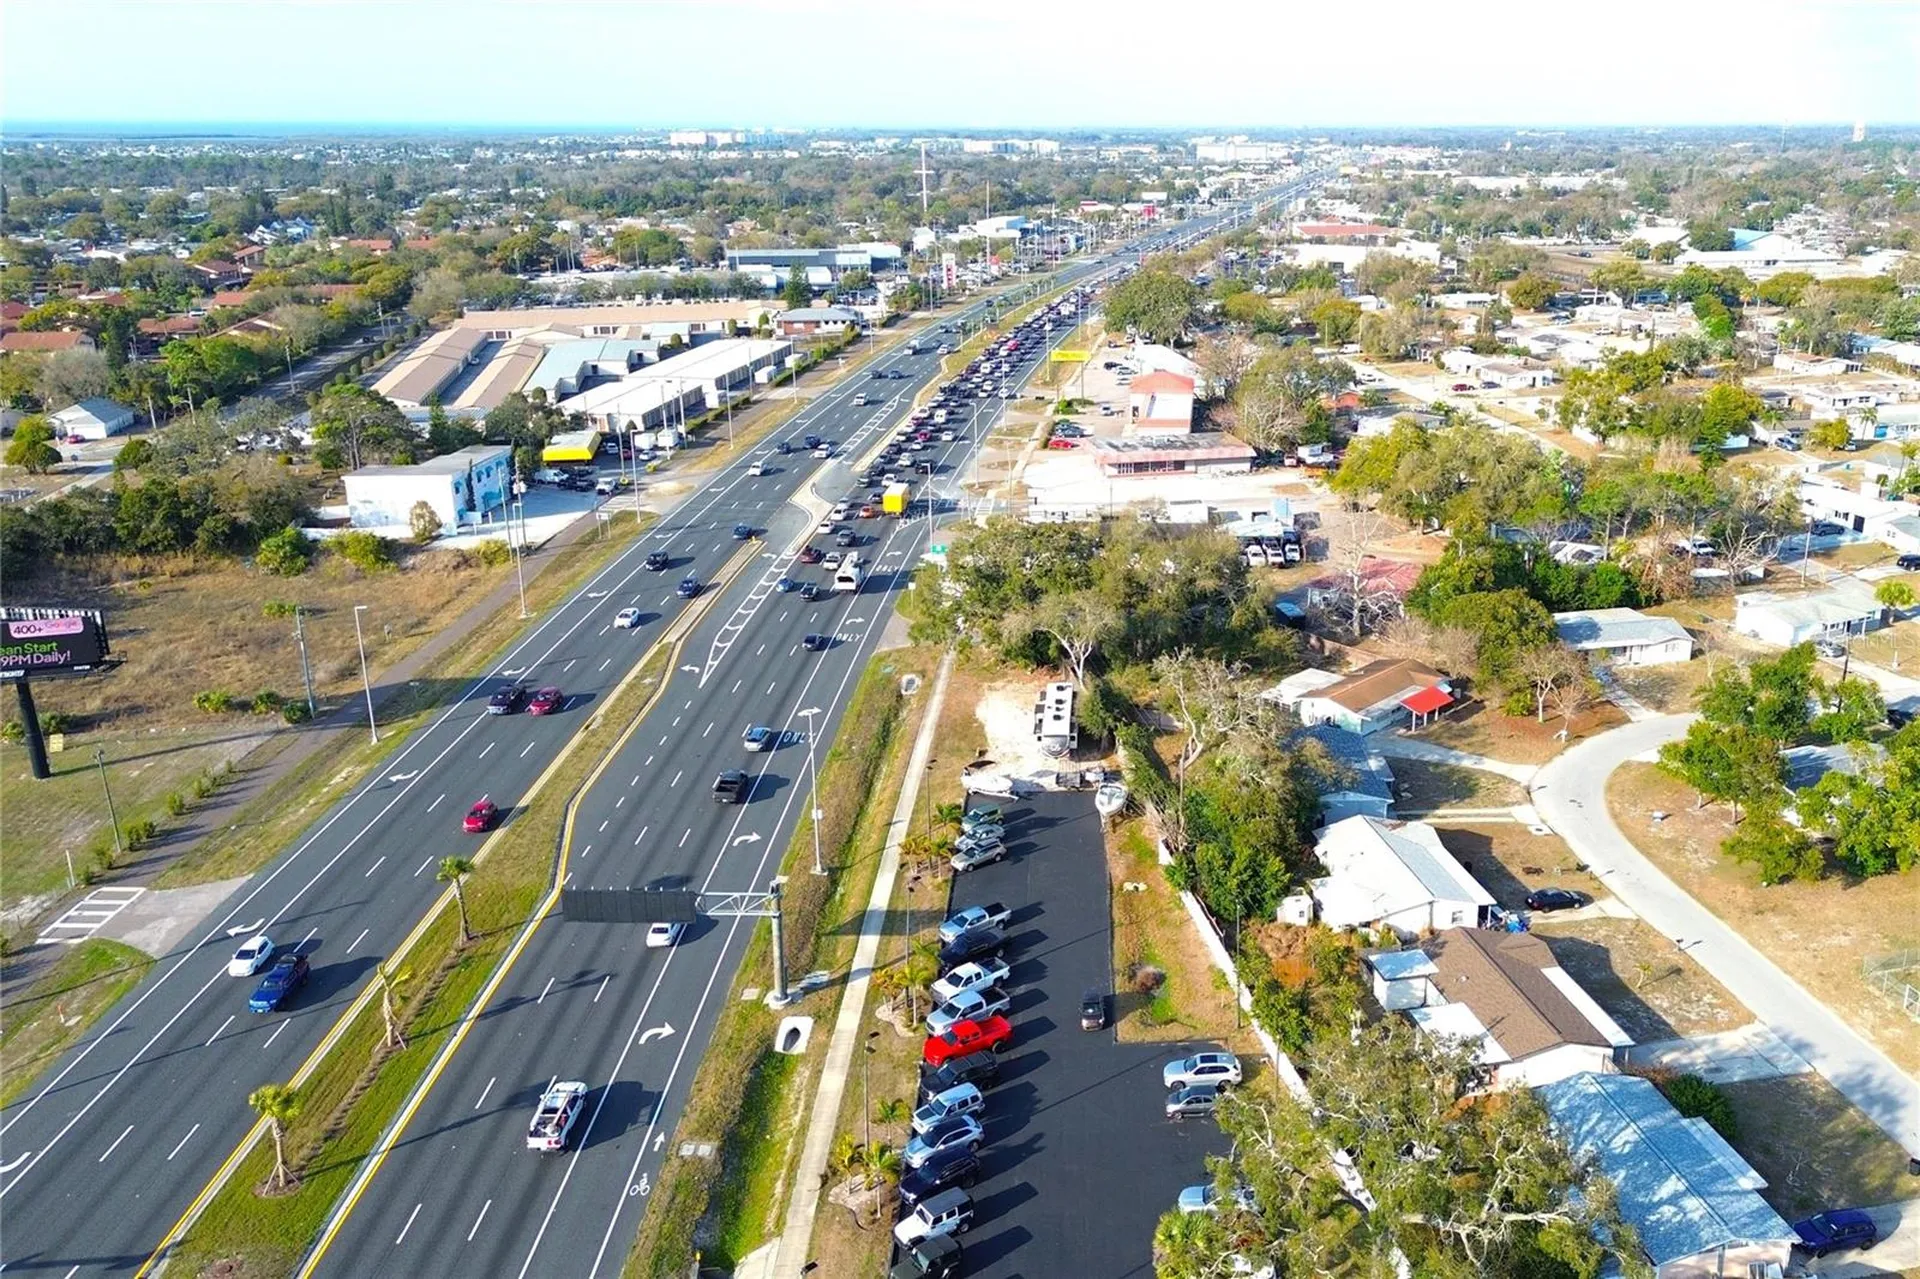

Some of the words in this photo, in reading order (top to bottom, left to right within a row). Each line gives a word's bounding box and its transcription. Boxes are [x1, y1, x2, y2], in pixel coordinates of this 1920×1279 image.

[14, 625, 43, 635] 400+
[836, 633, 864, 643] ONLY
[24, 642, 58, 654] Start
[0, 654, 32, 667] 9PM
[33, 650, 71, 665] Daily!
[783, 731, 818, 744] ONLY
